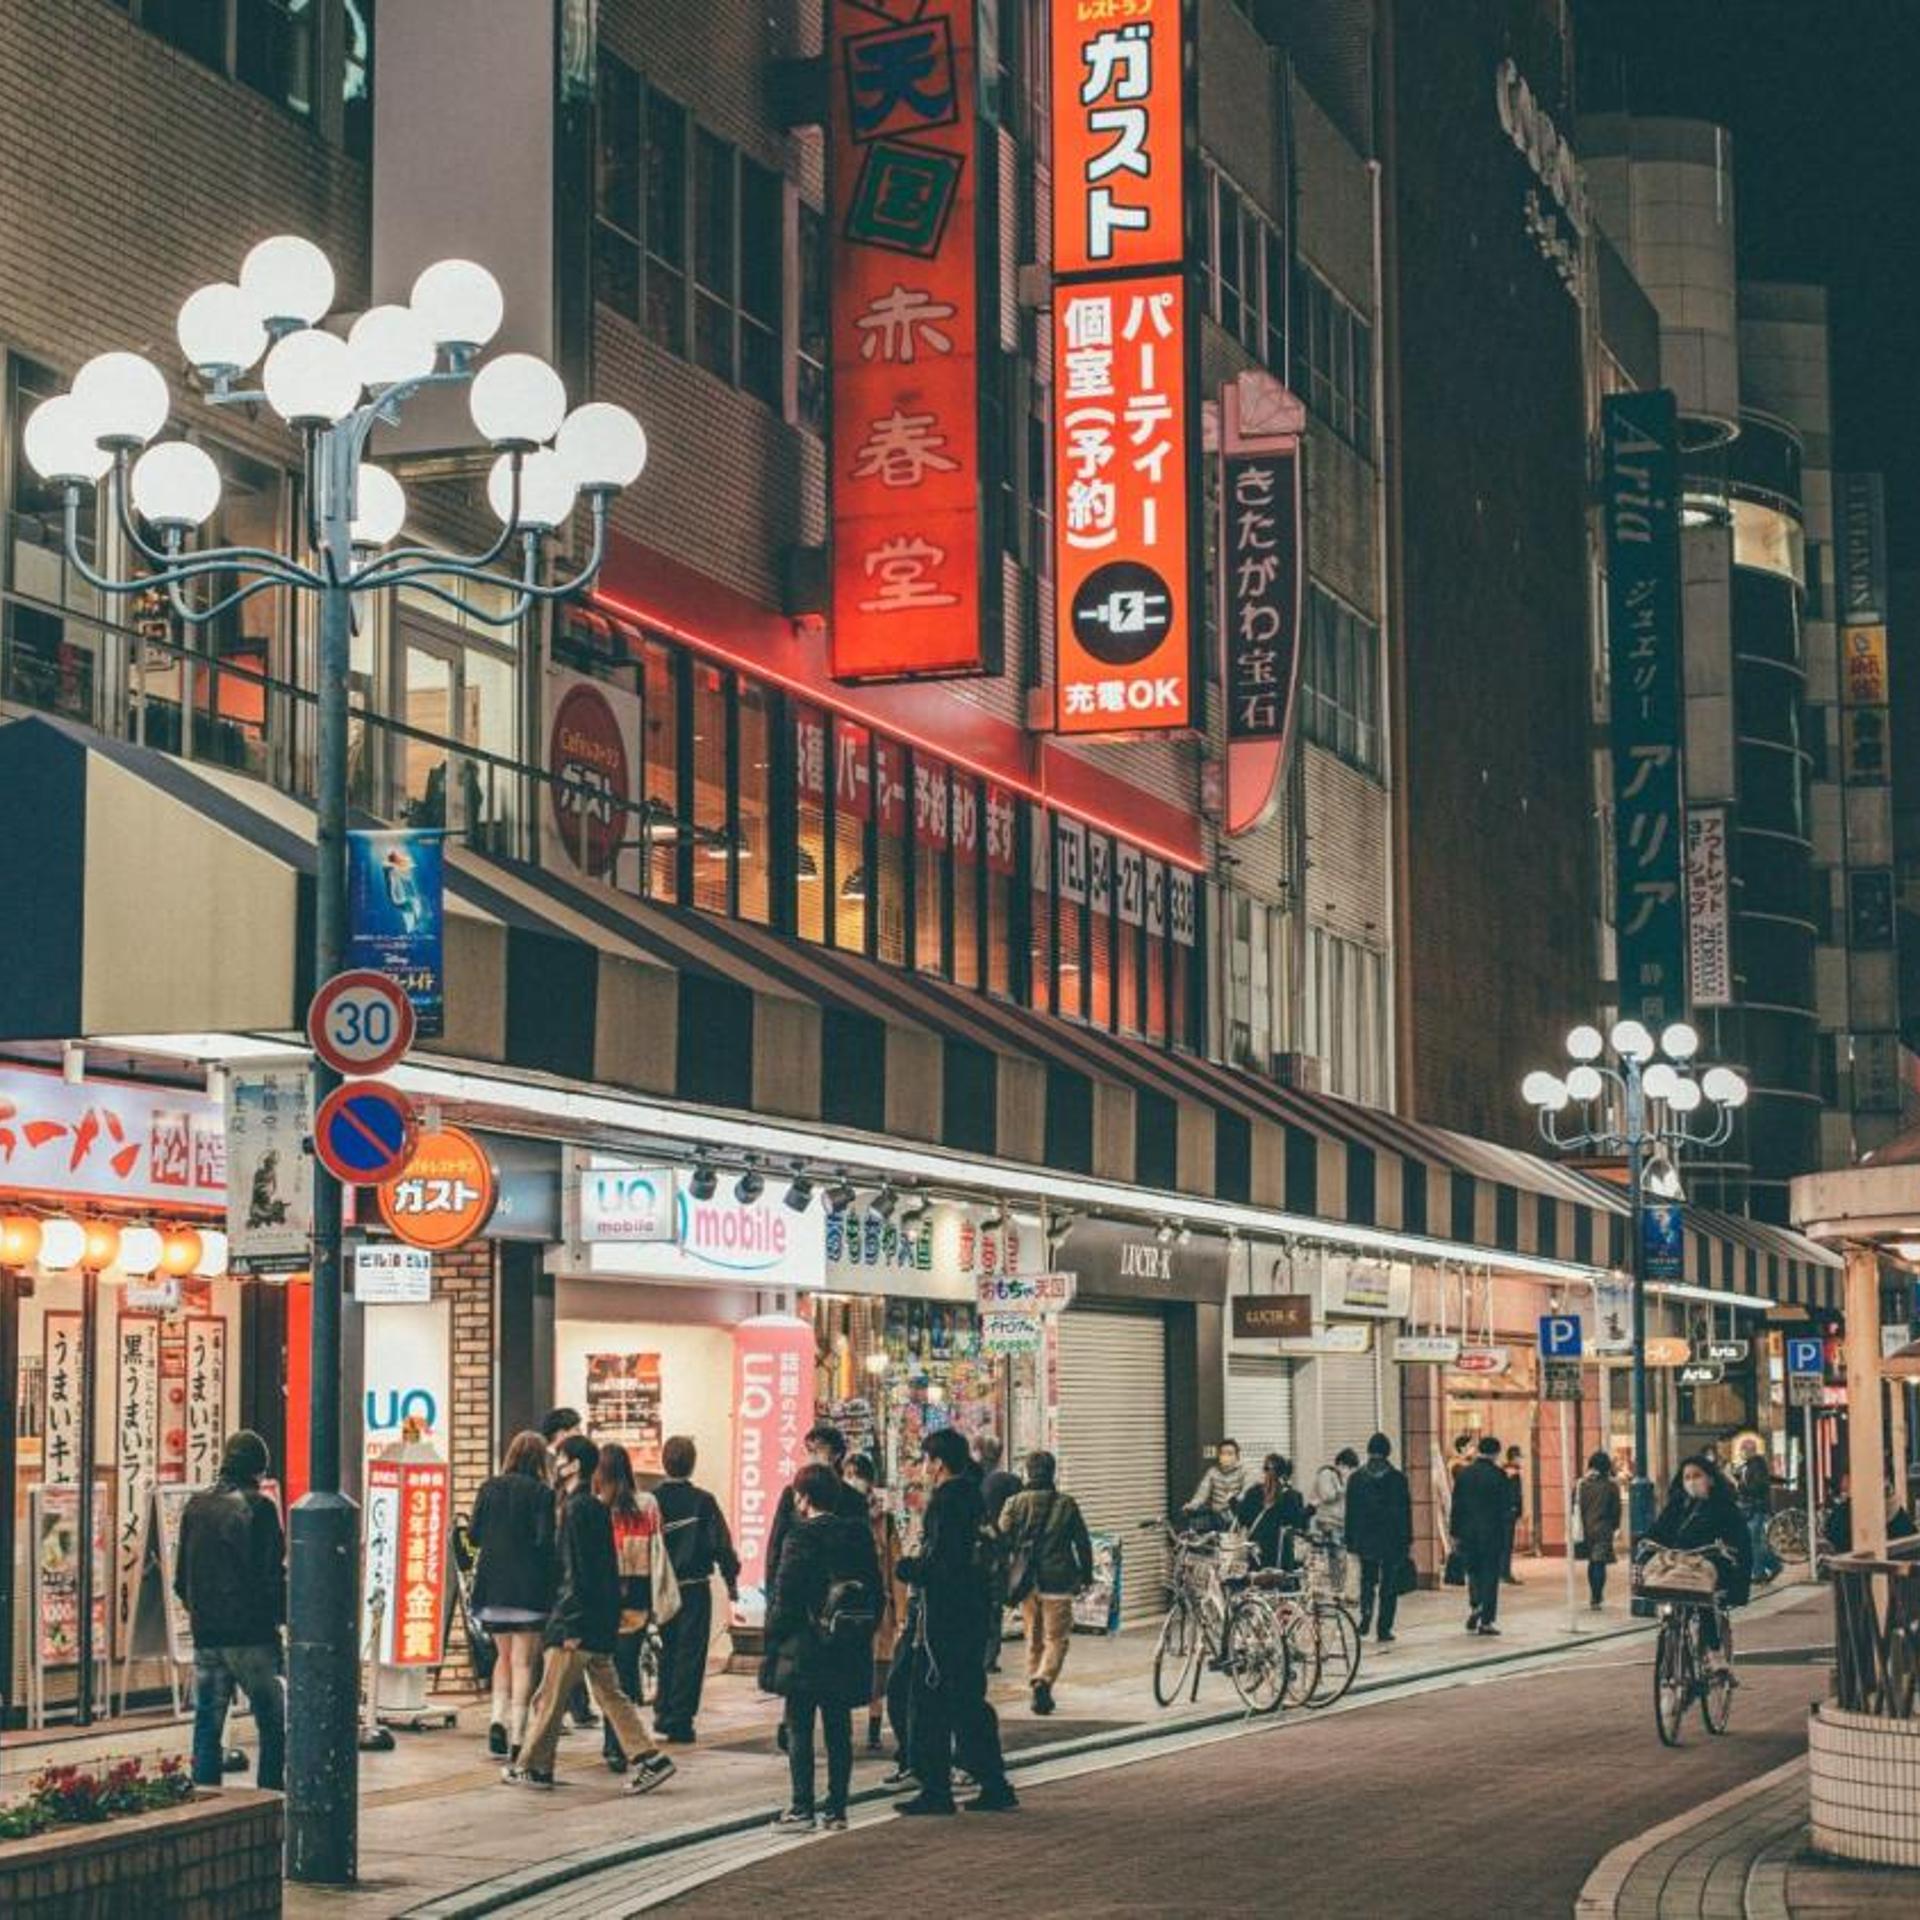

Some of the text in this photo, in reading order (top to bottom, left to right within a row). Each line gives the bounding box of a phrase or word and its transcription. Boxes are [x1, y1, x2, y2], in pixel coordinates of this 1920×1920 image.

[1081, 22, 1152, 260] ガスト
[1121, 292, 1174, 546] パーティー
[1613, 410, 1664, 543] Aria
[1234, 466, 1281, 731] きたがわ宝石
[1065, 677, 1183, 716] 充電OK
[1622, 744, 1677, 936] アリア
[335, 1001, 391, 1046] 30
[394, 1177, 480, 1214] ガスト
[596, 1218, 655, 1234] mobile
[694, 1207, 787, 1255] mobile
[1550, 1319, 1574, 1353] P
[1797, 1343, 1816, 1370] P
[121, 1333, 144, 1573] 黒うまいラーメン
[740, 1352, 775, 1560] UQ mobile
